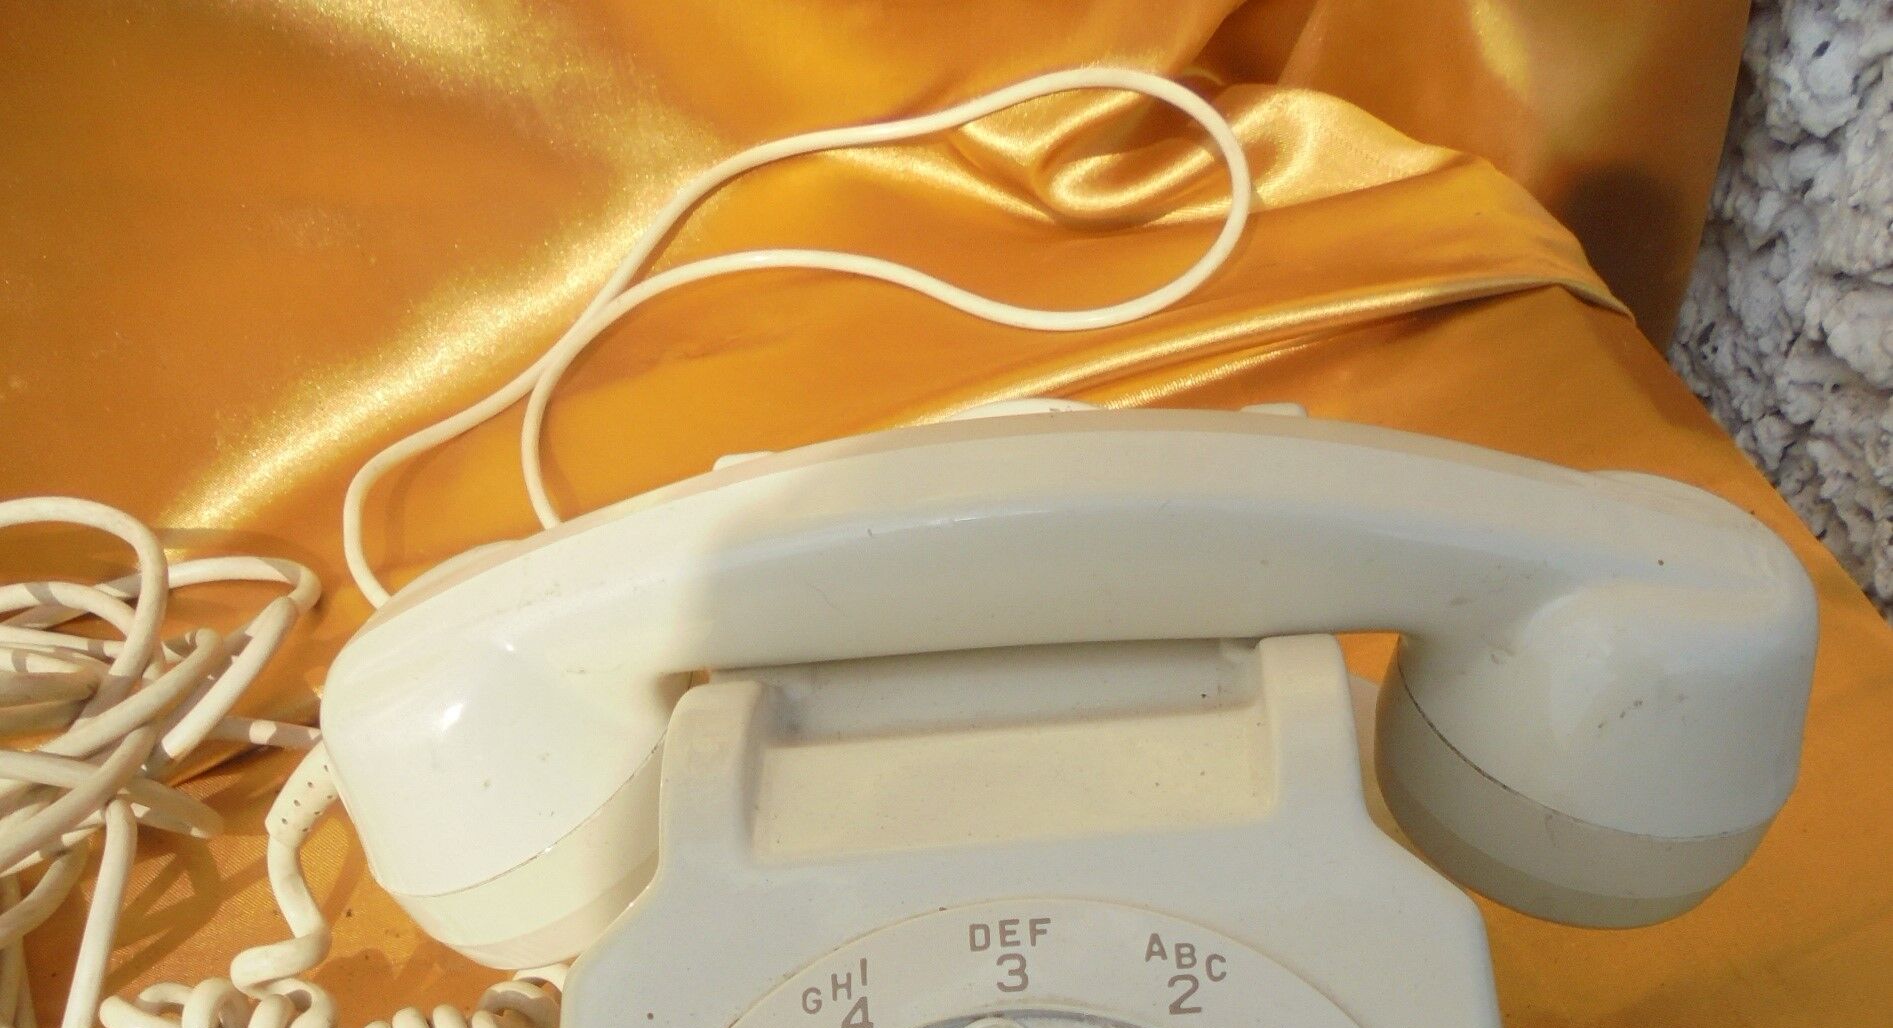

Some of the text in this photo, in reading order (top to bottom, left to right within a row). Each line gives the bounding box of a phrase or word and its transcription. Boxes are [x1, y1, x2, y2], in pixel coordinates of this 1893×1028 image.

[969, 918, 1052, 951] DEF
[996, 953, 1029, 992] 3
[1144, 933, 1228, 982] ABC
[801, 957, 869, 1014] GHI
[1168, 974, 1203, 1015] 2
